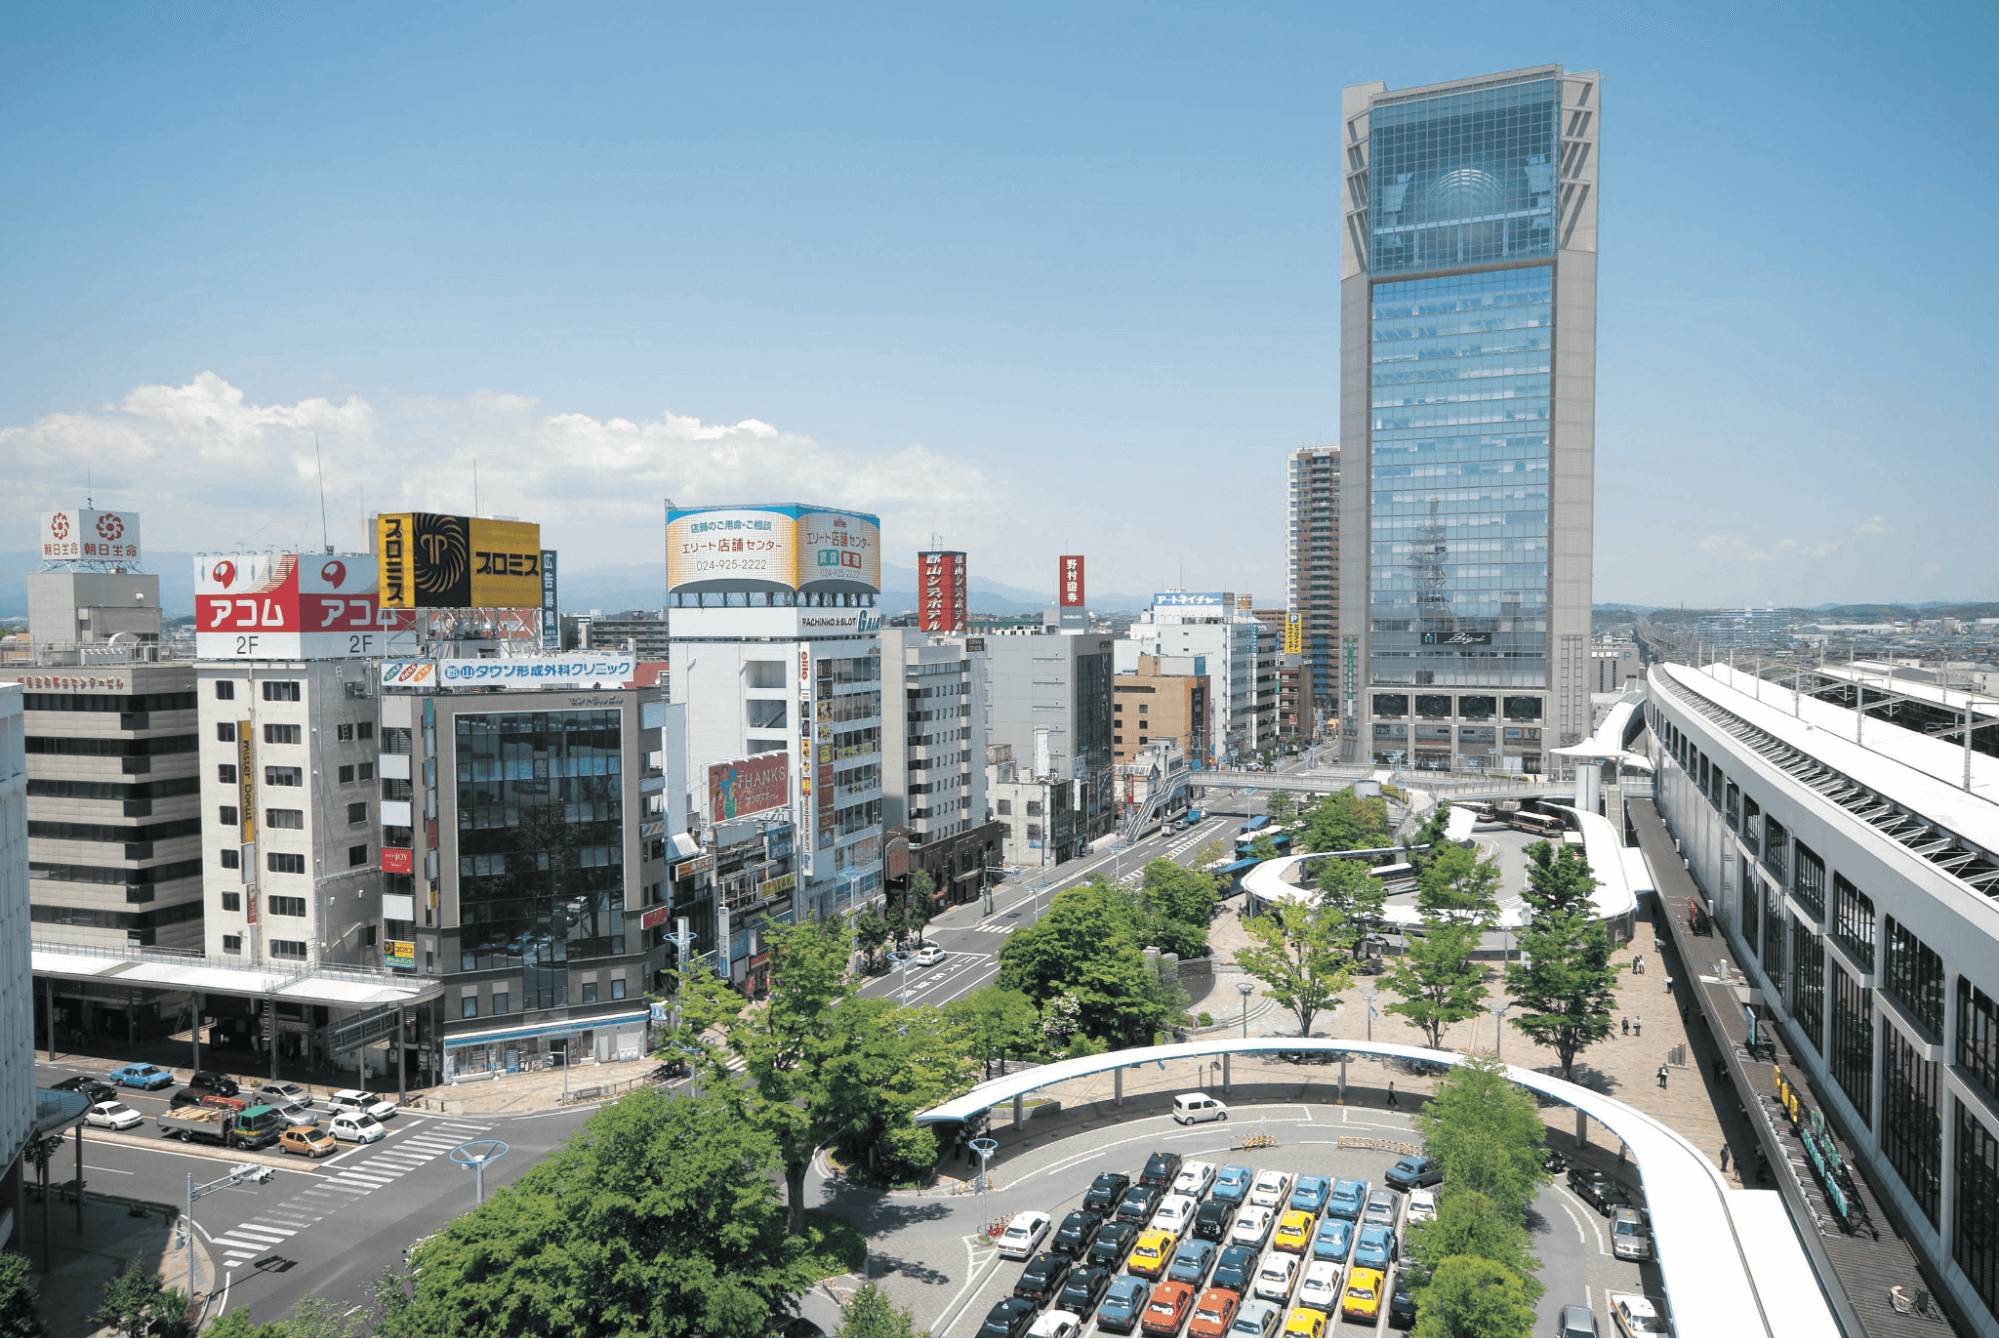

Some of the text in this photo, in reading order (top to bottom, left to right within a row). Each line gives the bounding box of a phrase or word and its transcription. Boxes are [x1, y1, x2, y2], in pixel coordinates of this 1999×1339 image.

[84, 543, 137, 558] 朝日生命
[386, 518, 403, 601] プロミス
[475, 551, 539, 577] プロミス
[696, 559, 767, 571] 024-925-2222
[210, 599, 284, 628] アコム
[321, 599, 398, 628] アコム
[1290, 614, 1298, 623] P
[236, 635, 259, 654] 2F
[349, 634, 373, 653] 2F
[737, 766, 786, 790] THANKS
